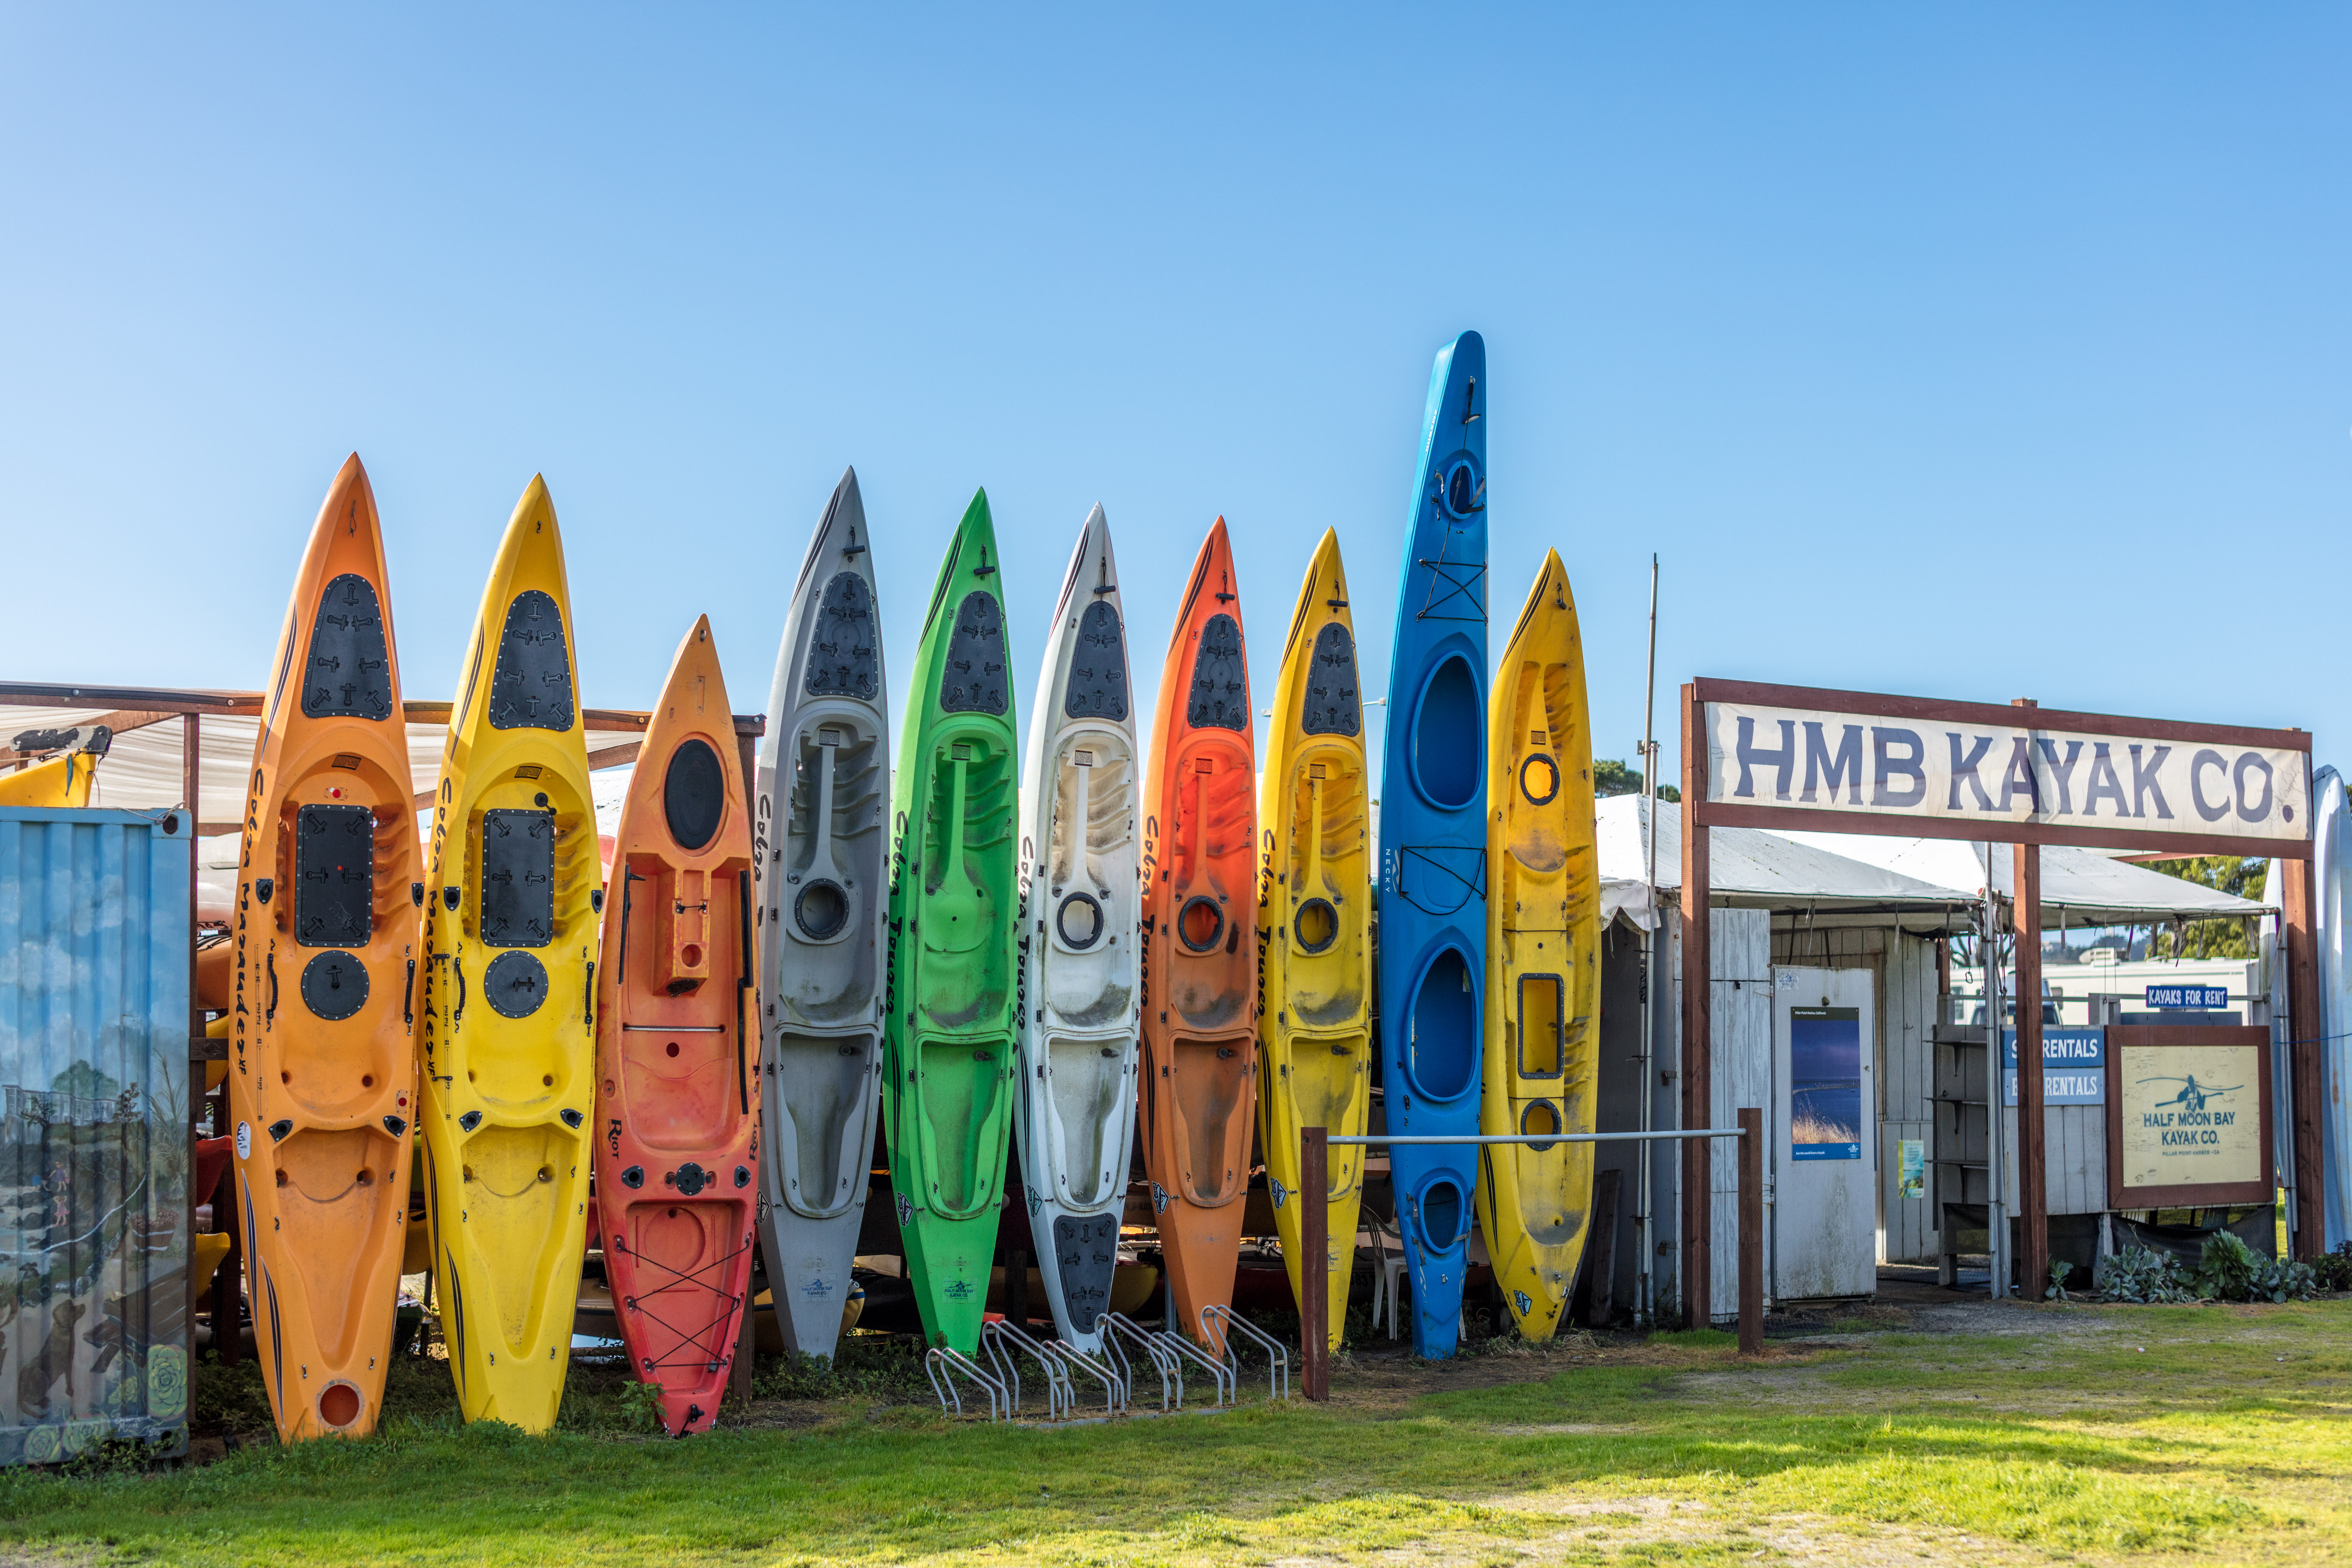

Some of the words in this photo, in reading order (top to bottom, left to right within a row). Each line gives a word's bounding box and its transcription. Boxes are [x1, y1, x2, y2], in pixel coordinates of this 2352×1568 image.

[1734, 716, 1925, 808] HMB
[1945, 733, 2174, 819] KAYAK
[2191, 749, 2294, 823] CO.
[243, 768, 263, 868] Cobra
[432, 777, 451, 873] Cobra
[891, 810, 908, 896] Cobra
[1141, 815, 1159, 898] Cobra
[1018, 836, 1034, 919] Cobra
[1260, 828, 1276, 908] Cobra
[2148, 989, 2181, 1005] KAYAKS
[2185, 990, 2201, 1005] FOR
[2205, 990, 2225, 1005] RENT
[2043, 1038, 2097, 1058] RENTALS
[2045, 1076, 2097, 1096] RENTALS
[2144, 1113, 2174, 1127] HALF
[2178, 1112, 2211, 1126] MOON
[2215, 1112, 2235, 1125] BAY
[2162, 1131, 2198, 1145] KAYAK
[2201, 1130, 2219, 1144] CO.
